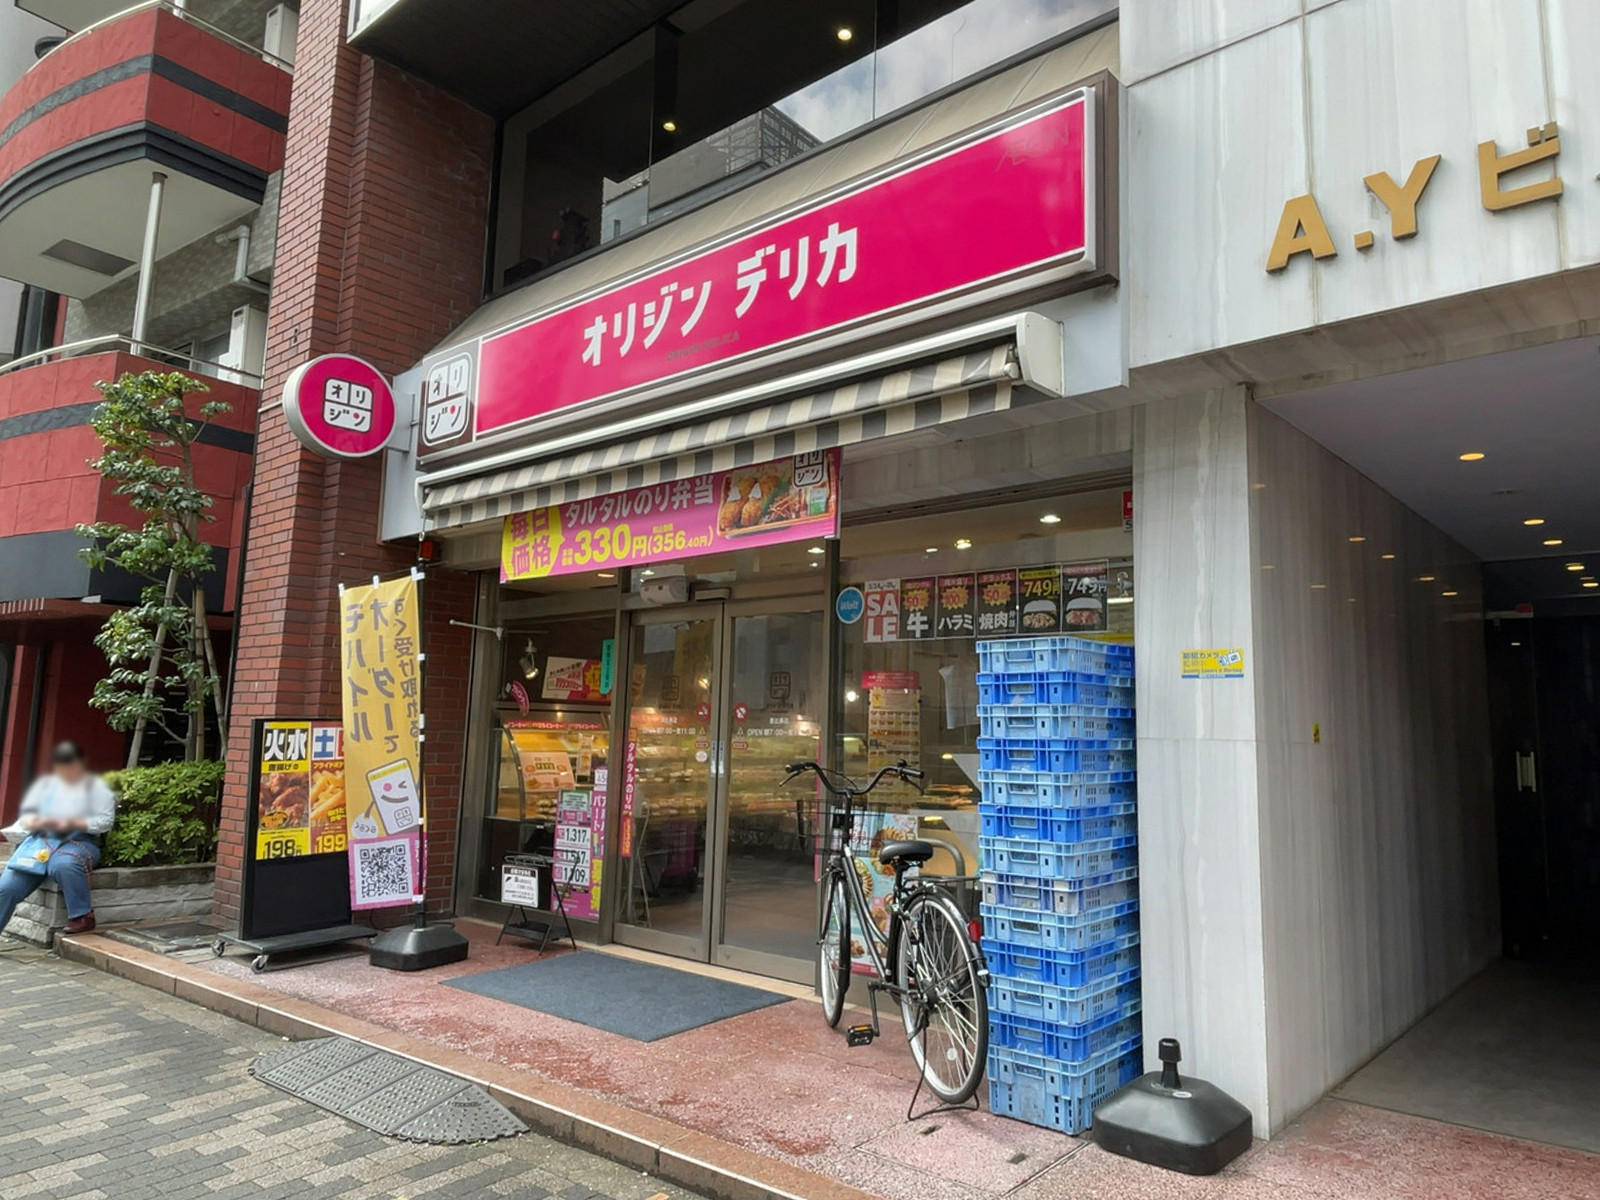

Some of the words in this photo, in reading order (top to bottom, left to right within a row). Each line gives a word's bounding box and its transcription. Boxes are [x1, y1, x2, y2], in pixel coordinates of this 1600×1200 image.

[582, 281, 712, 366] オリジン
[735, 222, 858, 319] デリカ
[565, 474, 715, 529] タルタルのり弁当
[906, 611, 929, 638] 牛
[938, 613, 974, 631] ハラミ
